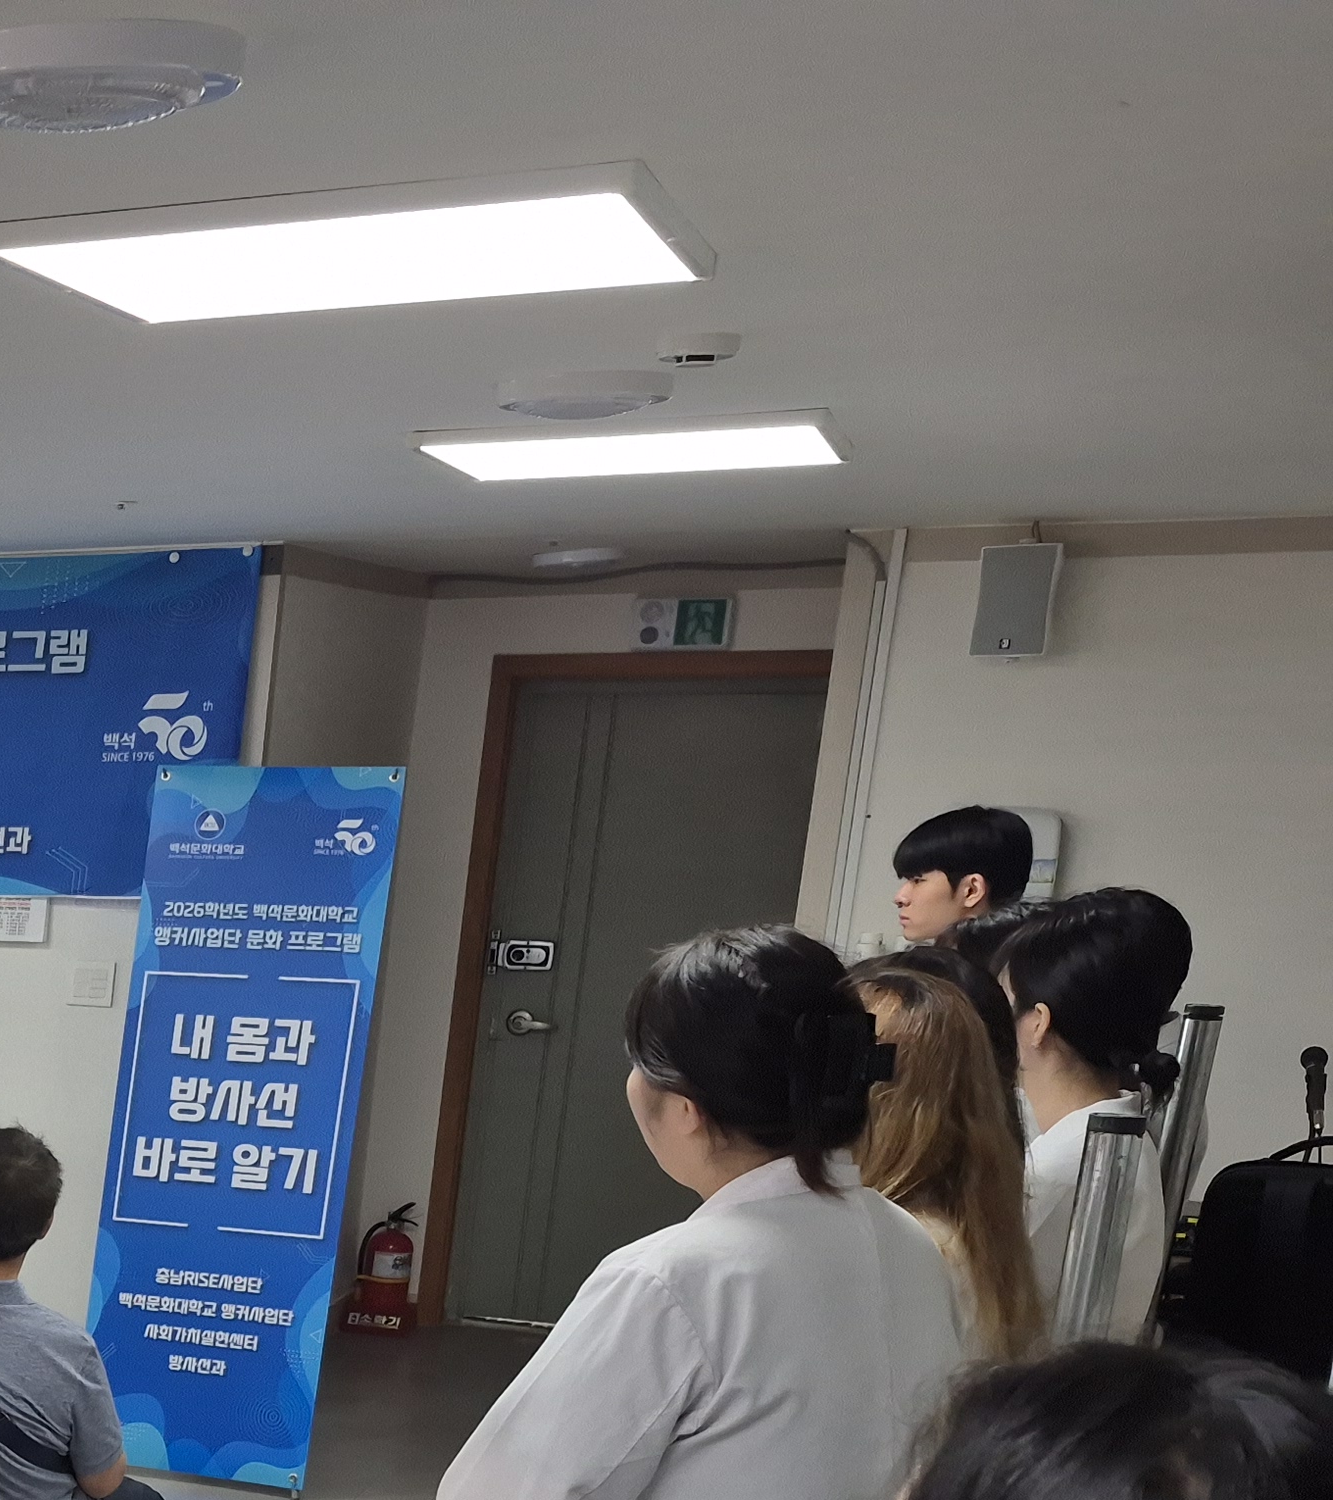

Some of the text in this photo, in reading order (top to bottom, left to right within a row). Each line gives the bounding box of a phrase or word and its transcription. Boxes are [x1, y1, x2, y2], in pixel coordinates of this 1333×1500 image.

[103, 732, 136, 750] 백석
[102, 751, 154, 762] SINCE 1976
[169, 843, 244, 855] 백석문화대학교
[163, 901, 358, 923] 2026학년도 백석문화대학교
[154, 926, 362, 953] 앵커사업단 문화 프로그램
[171, 1013, 315, 1065] 내 몸과
[169, 1076, 298, 1129] 방사선
[133, 1136, 318, 1194] 바로 알기
[155, 1267, 263, 1294] 충남RISE사업단
[119, 1292, 294, 1326] 백석문화대학교 앵커사업단
[144, 1323, 259, 1351] 사회가치실현센터
[168, 1355, 226, 1376] 방사선과
